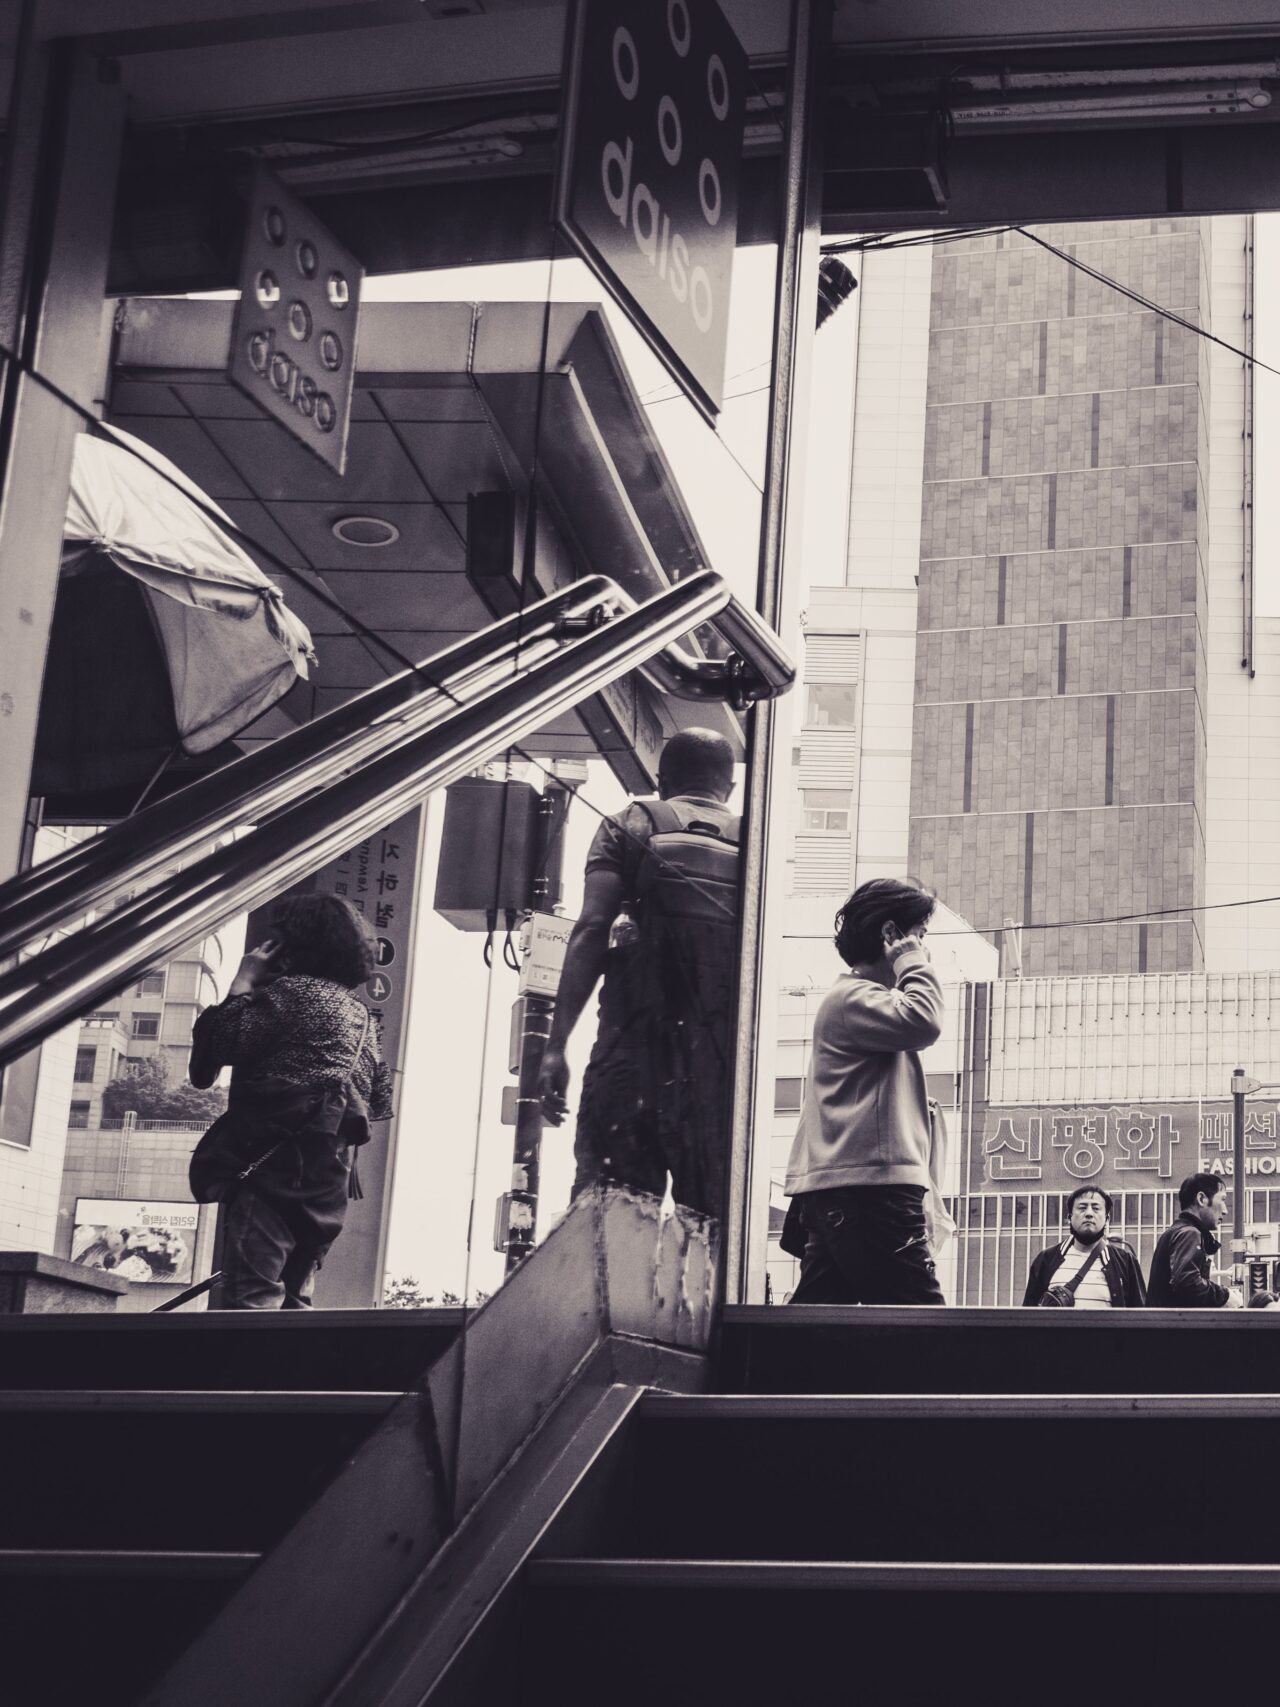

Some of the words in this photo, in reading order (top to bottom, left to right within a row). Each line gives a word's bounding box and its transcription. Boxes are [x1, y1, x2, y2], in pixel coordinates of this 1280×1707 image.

[601, 136, 713, 333] daiso
[249, 329, 336, 433] daiso
[985, 1112, 1179, 1179] 신평화
